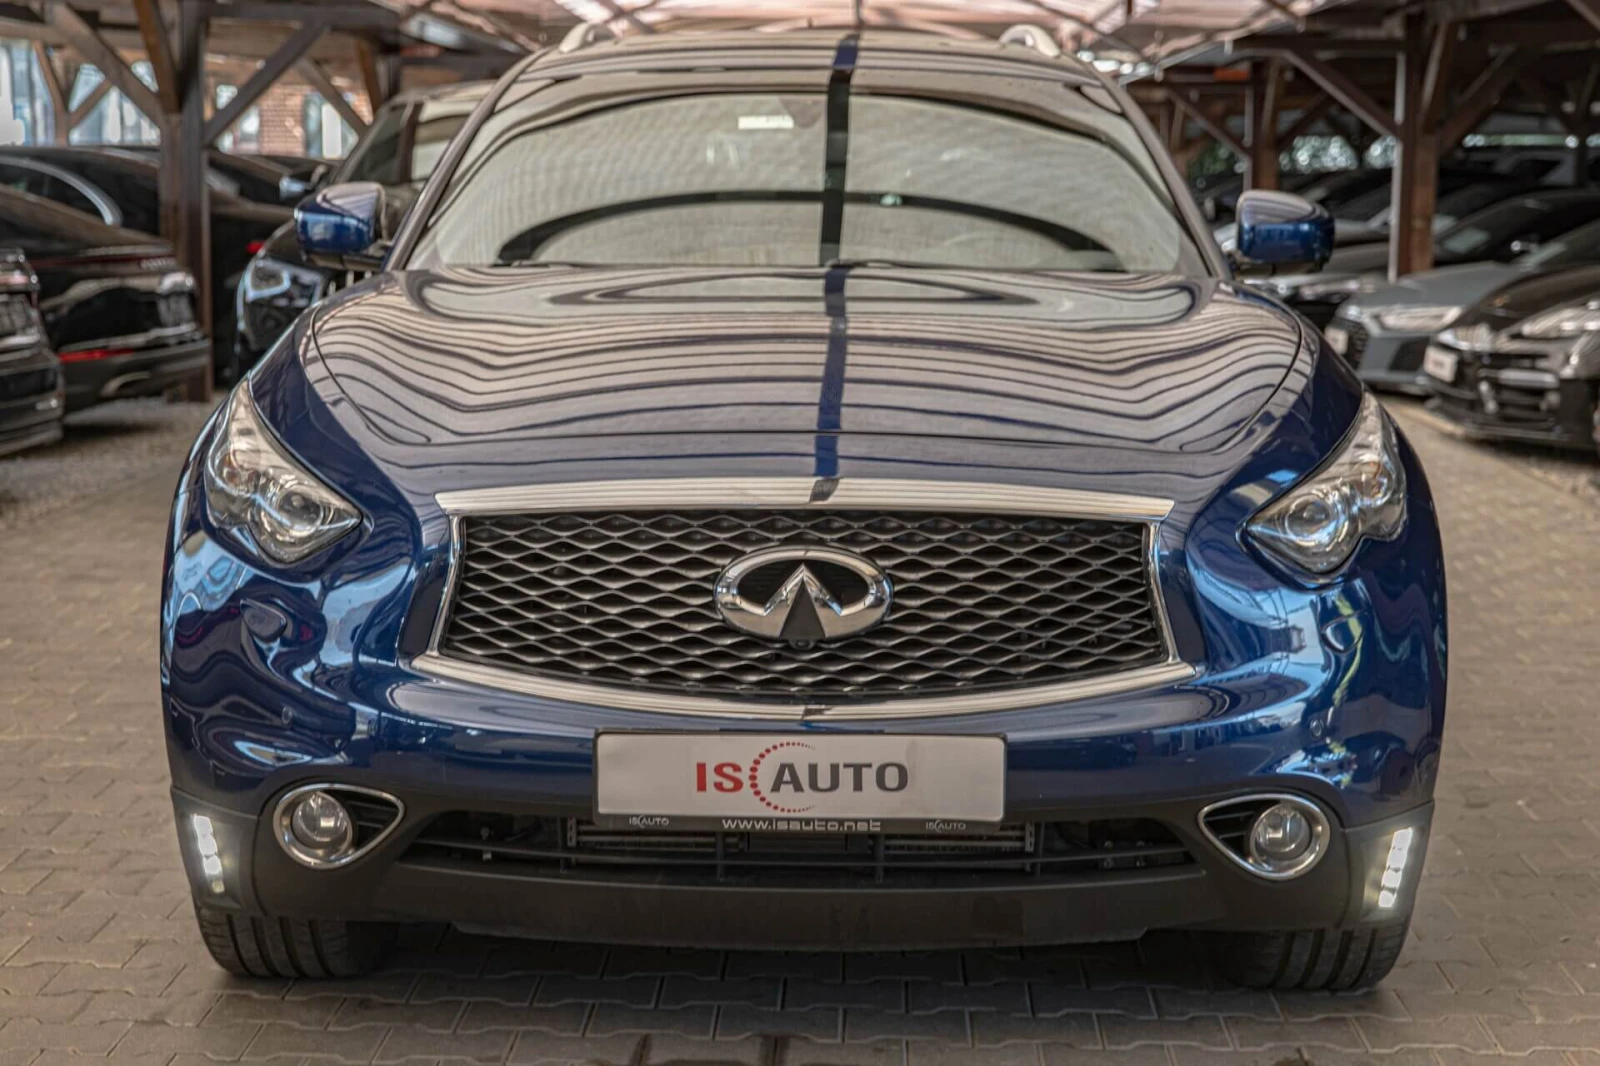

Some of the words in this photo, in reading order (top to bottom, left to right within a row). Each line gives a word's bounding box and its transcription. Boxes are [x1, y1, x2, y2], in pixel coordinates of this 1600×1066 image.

[696, 762, 744, 793] IS
[770, 762, 909, 793] AUTO
[722, 818, 881, 832] www.isauto.net
